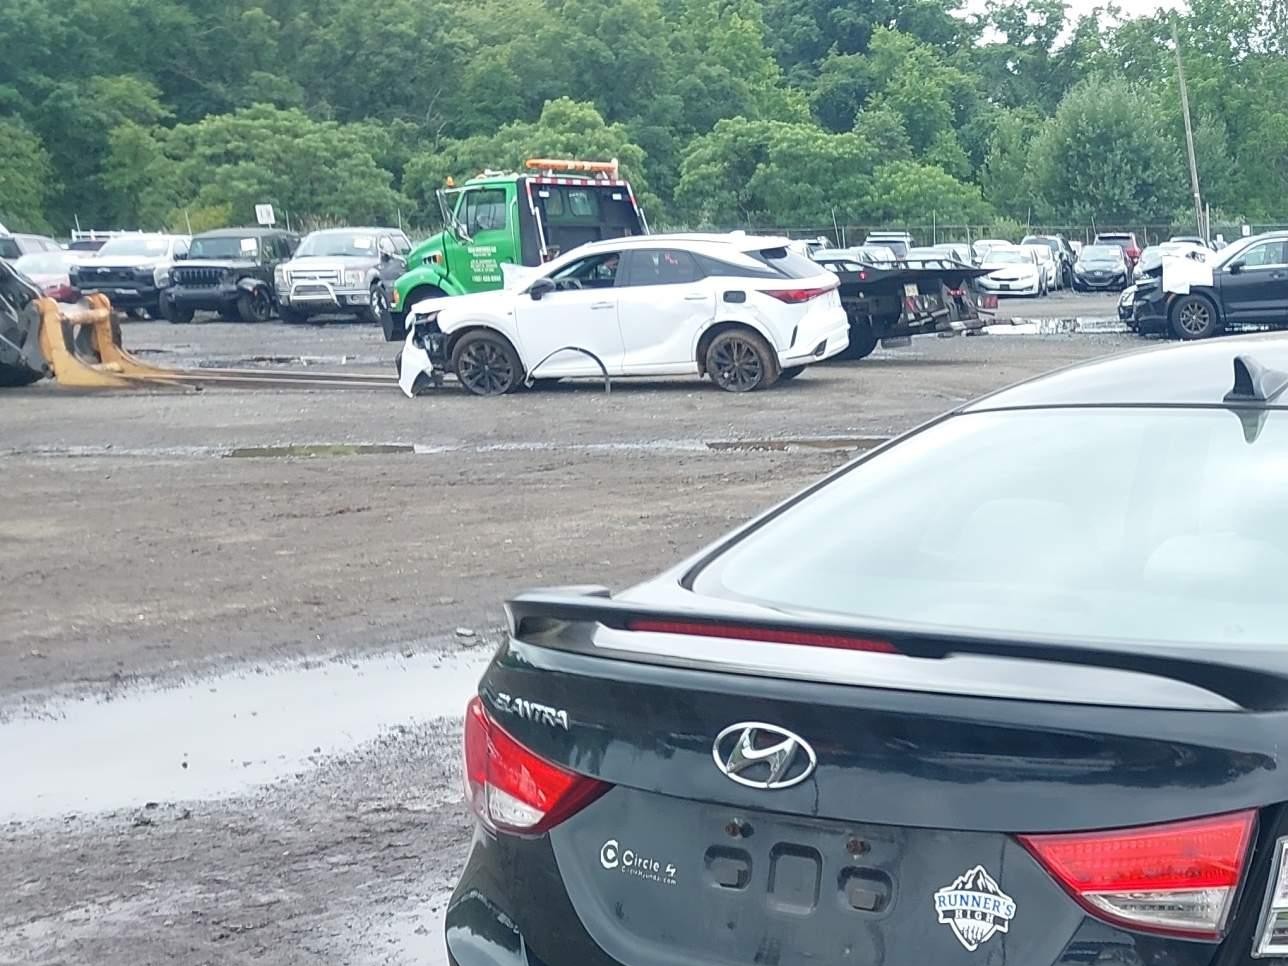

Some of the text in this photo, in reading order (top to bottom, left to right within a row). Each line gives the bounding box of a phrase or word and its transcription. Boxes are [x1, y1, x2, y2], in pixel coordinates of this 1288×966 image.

[622, 849, 660, 872] Circle
[937, 894, 1014, 917] RUNNER'S
[955, 909, 995, 924] HIGH
